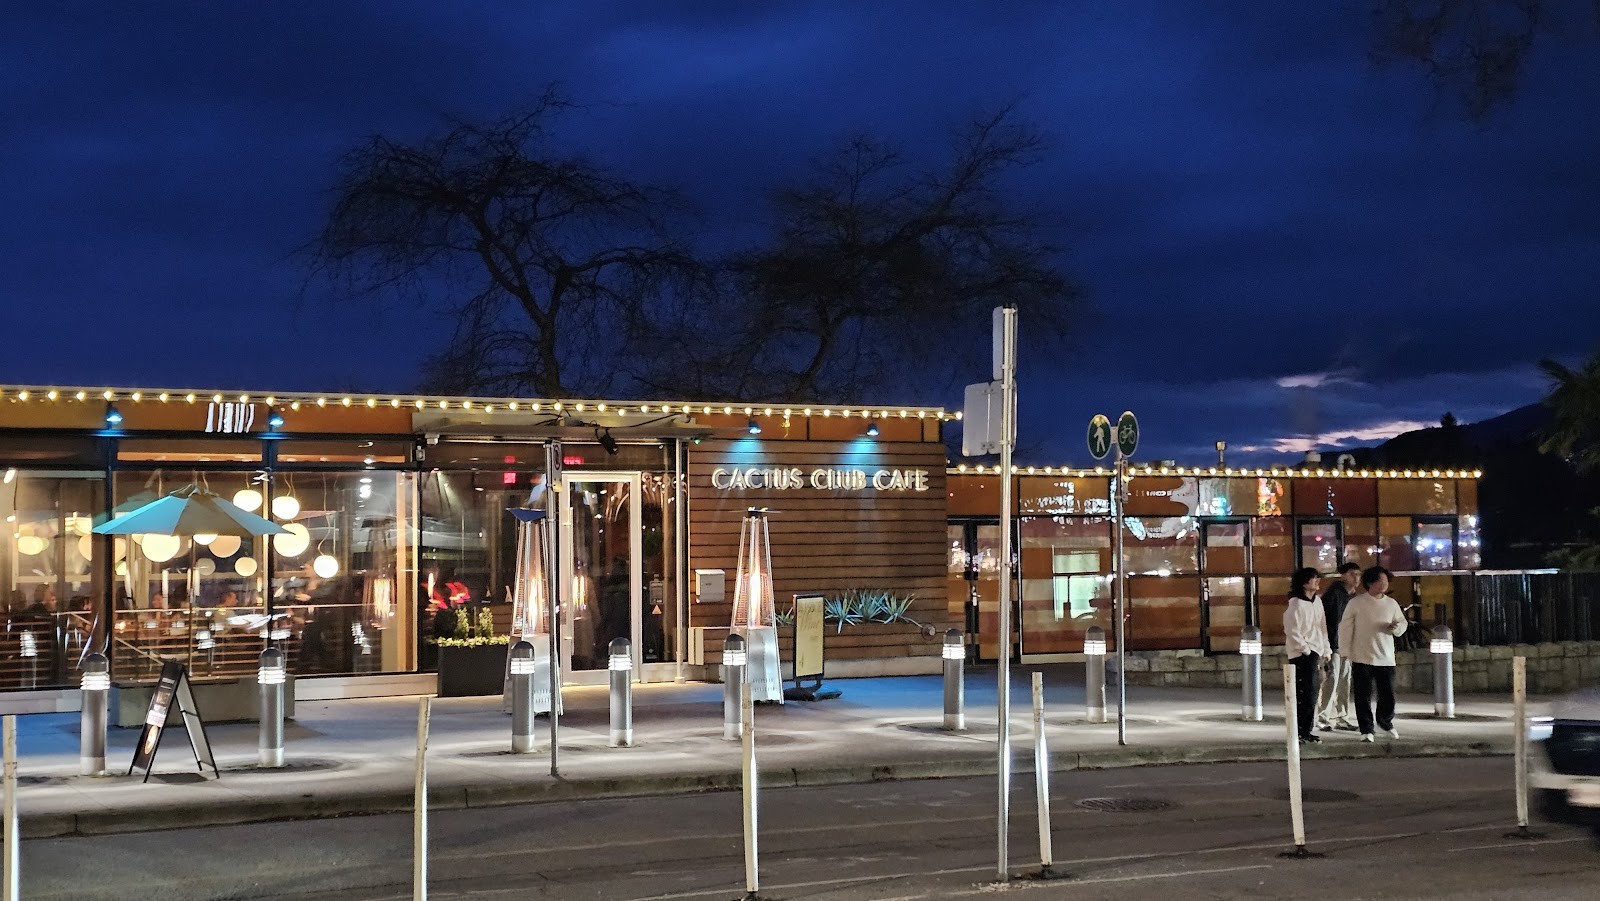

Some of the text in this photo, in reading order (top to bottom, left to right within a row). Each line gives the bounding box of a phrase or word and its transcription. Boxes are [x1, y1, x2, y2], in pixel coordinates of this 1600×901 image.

[711, 467, 930, 492] CACTUS CLUB CAFE
